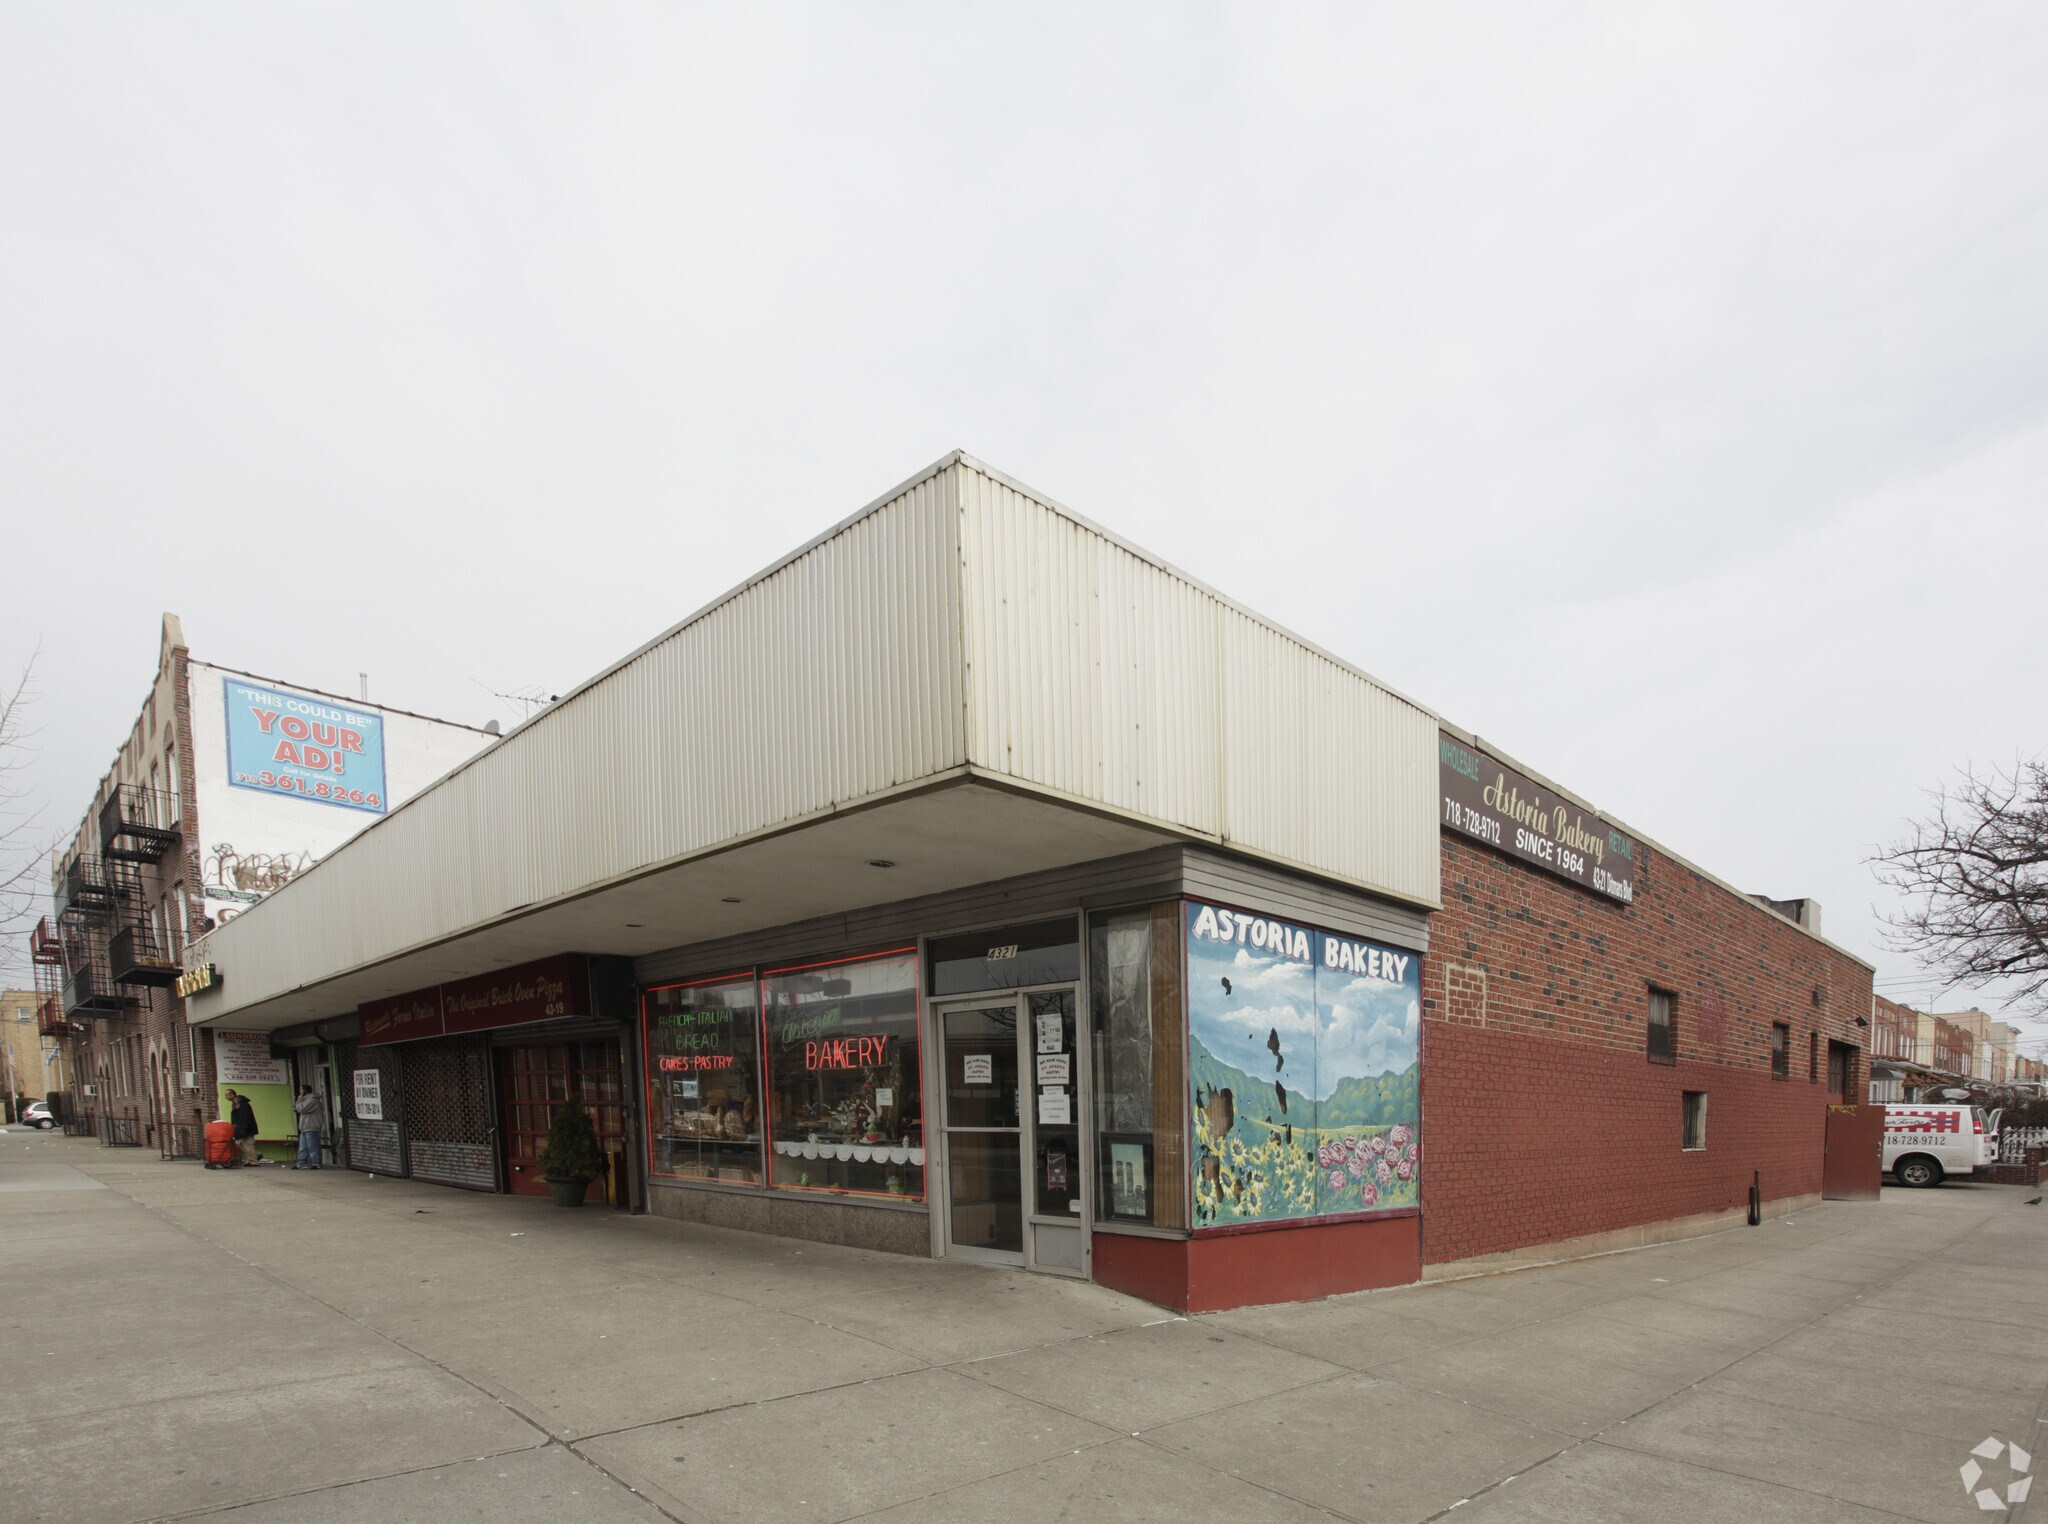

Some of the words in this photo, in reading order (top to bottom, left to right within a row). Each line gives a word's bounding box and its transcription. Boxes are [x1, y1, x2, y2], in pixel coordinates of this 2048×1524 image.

[286, 700, 342, 721] COULD
[249, 706, 365, 754] YOUR
[272, 739, 344, 775] AD!
[283, 766, 298, 775] Call
[300, 768, 310, 777] for
[312, 771, 337, 782] details
[1440, 738, 1479, 781] WHOLESALE
[236, 773, 259, 784] 718
[259, 771, 380, 807] 361.8264
[1445, 797, 1461, 826] 718
[1483, 773, 1549, 836] Astoria
[1553, 806, 1605, 865] Bakery
[1515, 828, 1554, 861] SINCE
[1557, 847, 1584, 876] 1964
[1608, 830, 1632, 860] RETAIL
[1593, 867, 1606, 892] 43-21
[1607, 872, 1623, 899] Ditmars
[1623, 879, 1632, 902] Blvd
[988, 946, 1015, 959] 4321
[1192, 905, 1310, 966] ASTORIA
[1324, 938, 1409, 983] BAKERY
[447, 996, 459, 1015] The
[460, 991, 489, 1015] Original
[490, 987, 512, 1006] Brick
[515, 981, 535, 1001] Oven
[537, 976, 563, 1003] Pizza
[545, 1002, 564, 1015] 43-19
[676, 1033, 718, 1050] BREAD
[806, 1034, 887, 1070] BAKERY
[356, 1087, 361, 1098] BY
[362, 1087, 378, 1098] OWNER
[364, 1073, 376, 1085] RENT
